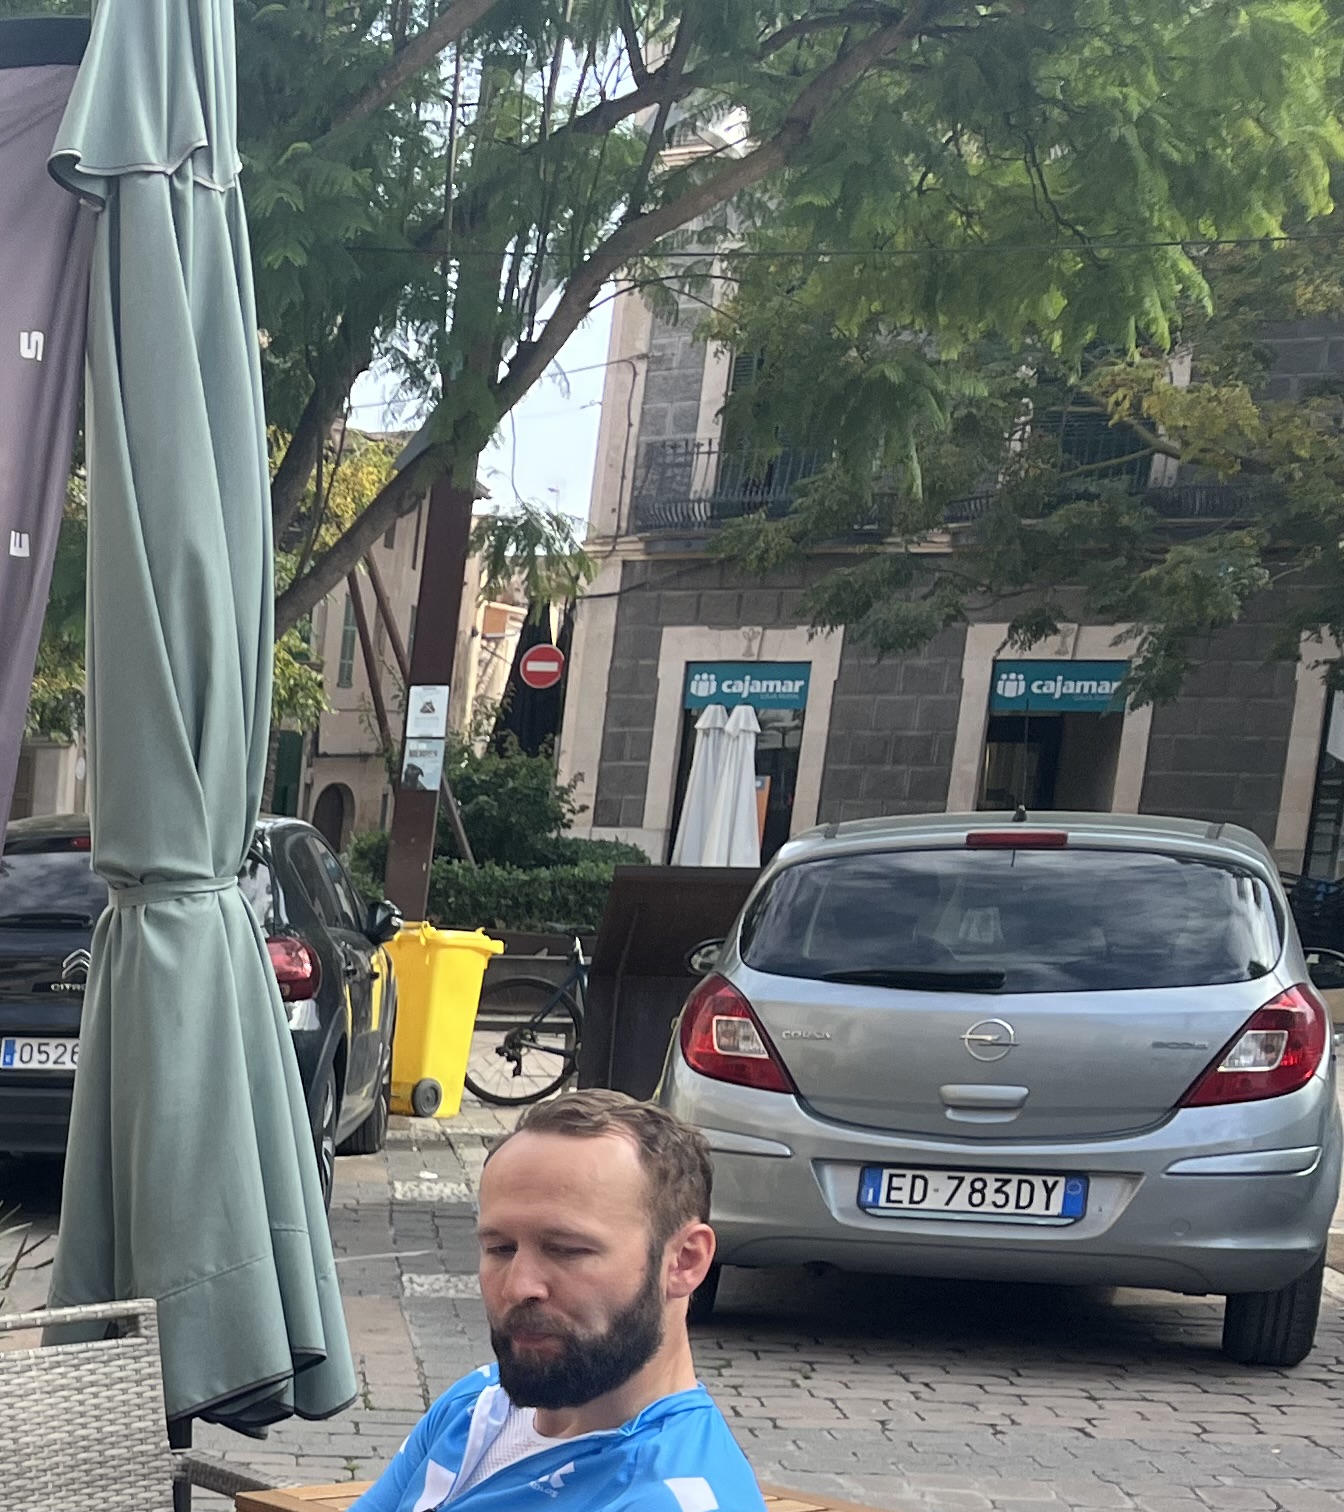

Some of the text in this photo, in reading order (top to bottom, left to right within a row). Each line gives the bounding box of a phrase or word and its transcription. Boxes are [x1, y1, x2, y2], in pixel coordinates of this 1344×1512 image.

[721, 674, 805, 699] cajamar
[885, 1173, 1060, 1212] ED 783DY
